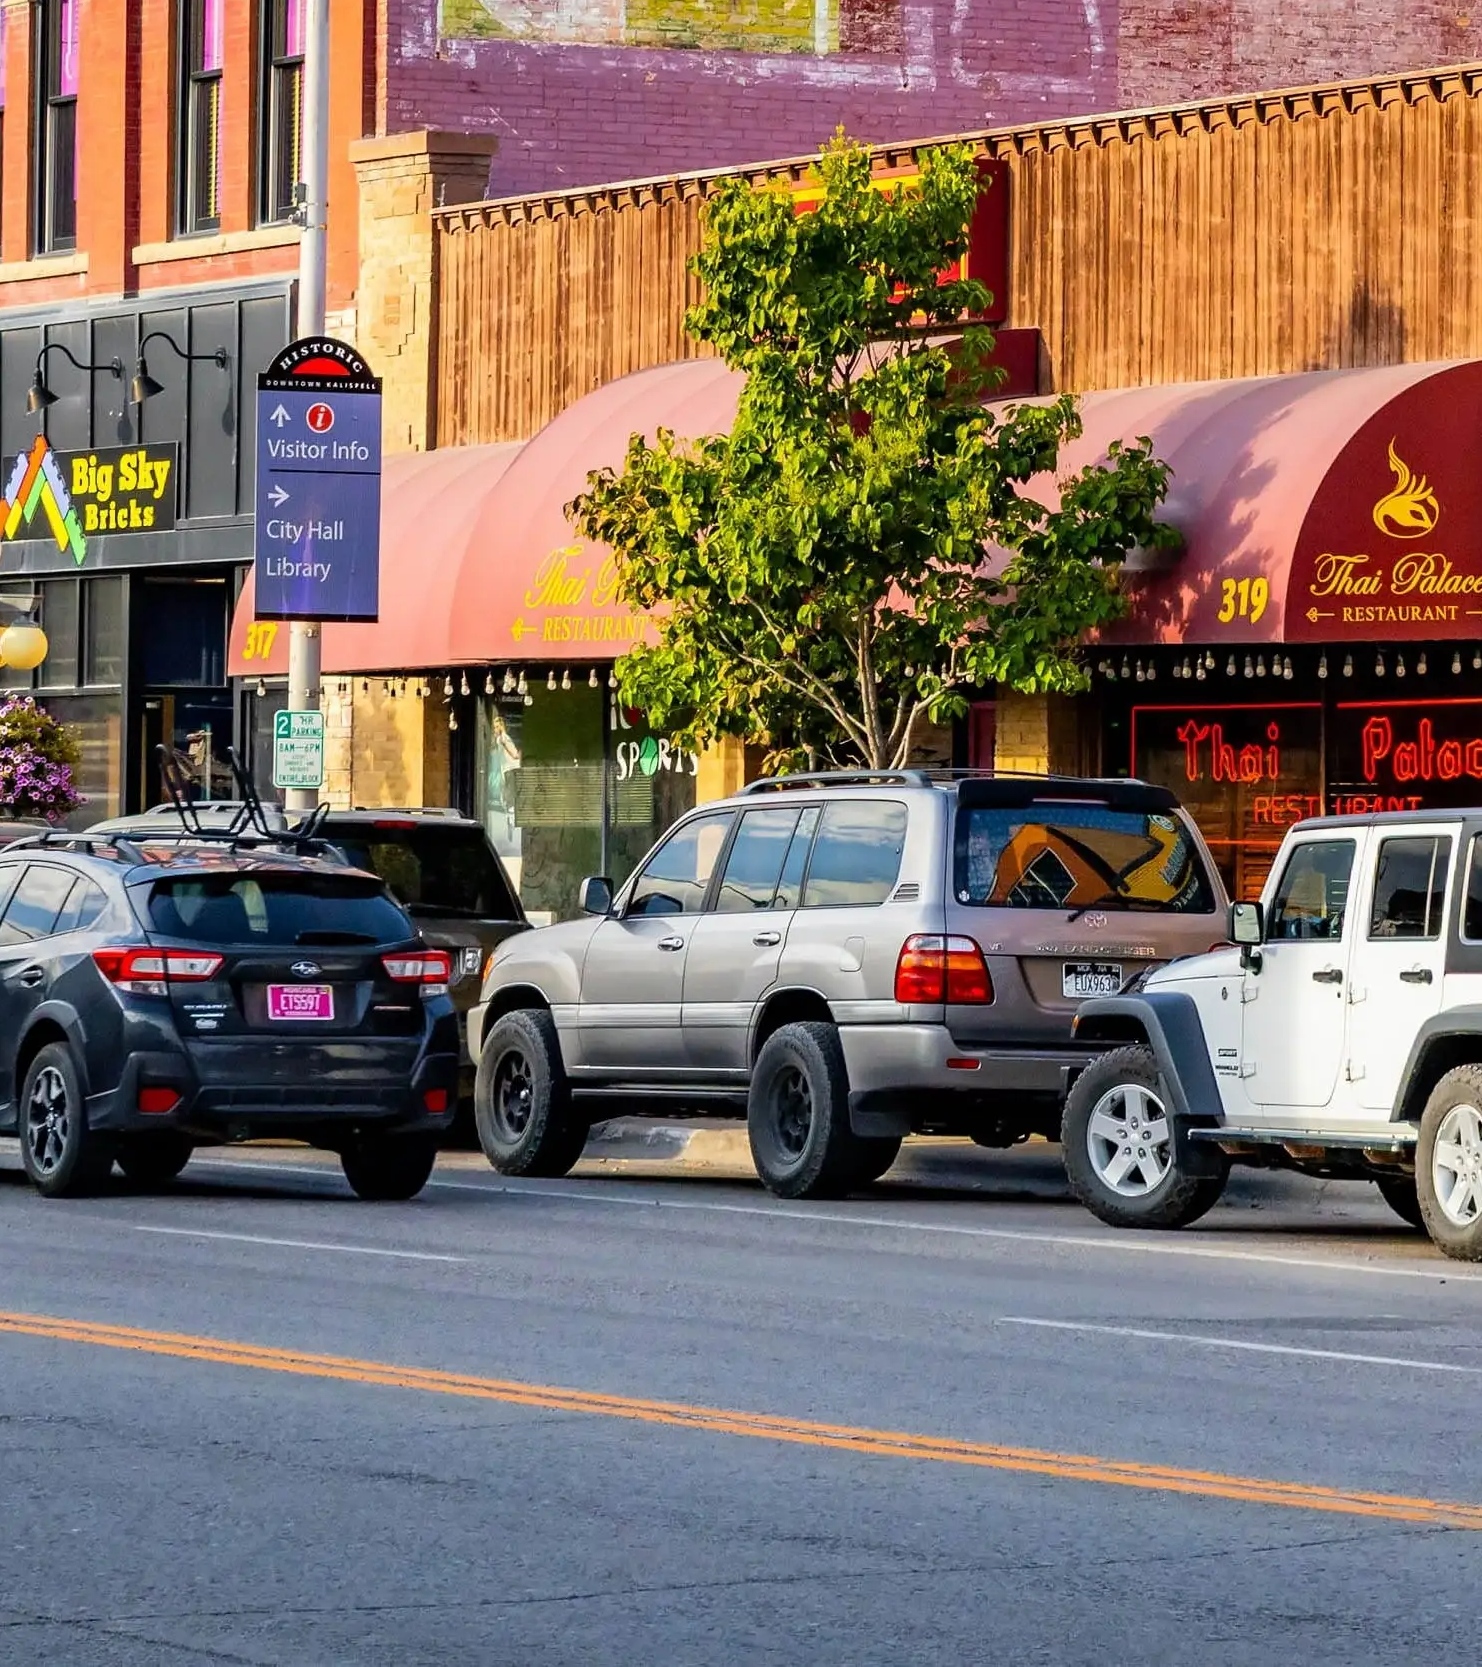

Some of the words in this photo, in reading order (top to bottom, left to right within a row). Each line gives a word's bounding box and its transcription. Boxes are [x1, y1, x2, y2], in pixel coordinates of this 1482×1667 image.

[279, 342, 363, 373] HISTORIC
[266, 379, 321, 388] DOWNTOWN
[326, 381, 376, 391] KALISPELL
[267, 438, 327, 460] Visitor
[333, 440, 369, 461] Info
[71, 454, 114, 502] Big
[118, 450, 171, 499] Sky
[84, 498, 155, 531] Bricks
[266, 519, 304, 544] City
[308, 519, 344, 541] Hall
[266, 556, 332, 583] Library
[524, 544, 592, 609] Thai
[1310, 553, 1382, 596] Thai
[1218, 577, 1269, 624] 319
[1342, 605, 1459, 623] RESTAURANT
[241, 622, 278, 661] 317
[543, 615, 649, 642] RESTAURANT
[277, 716, 289, 735] 2
[1177, 719, 1280, 782] Thai
[1075, 975, 1111, 992] EUX963
